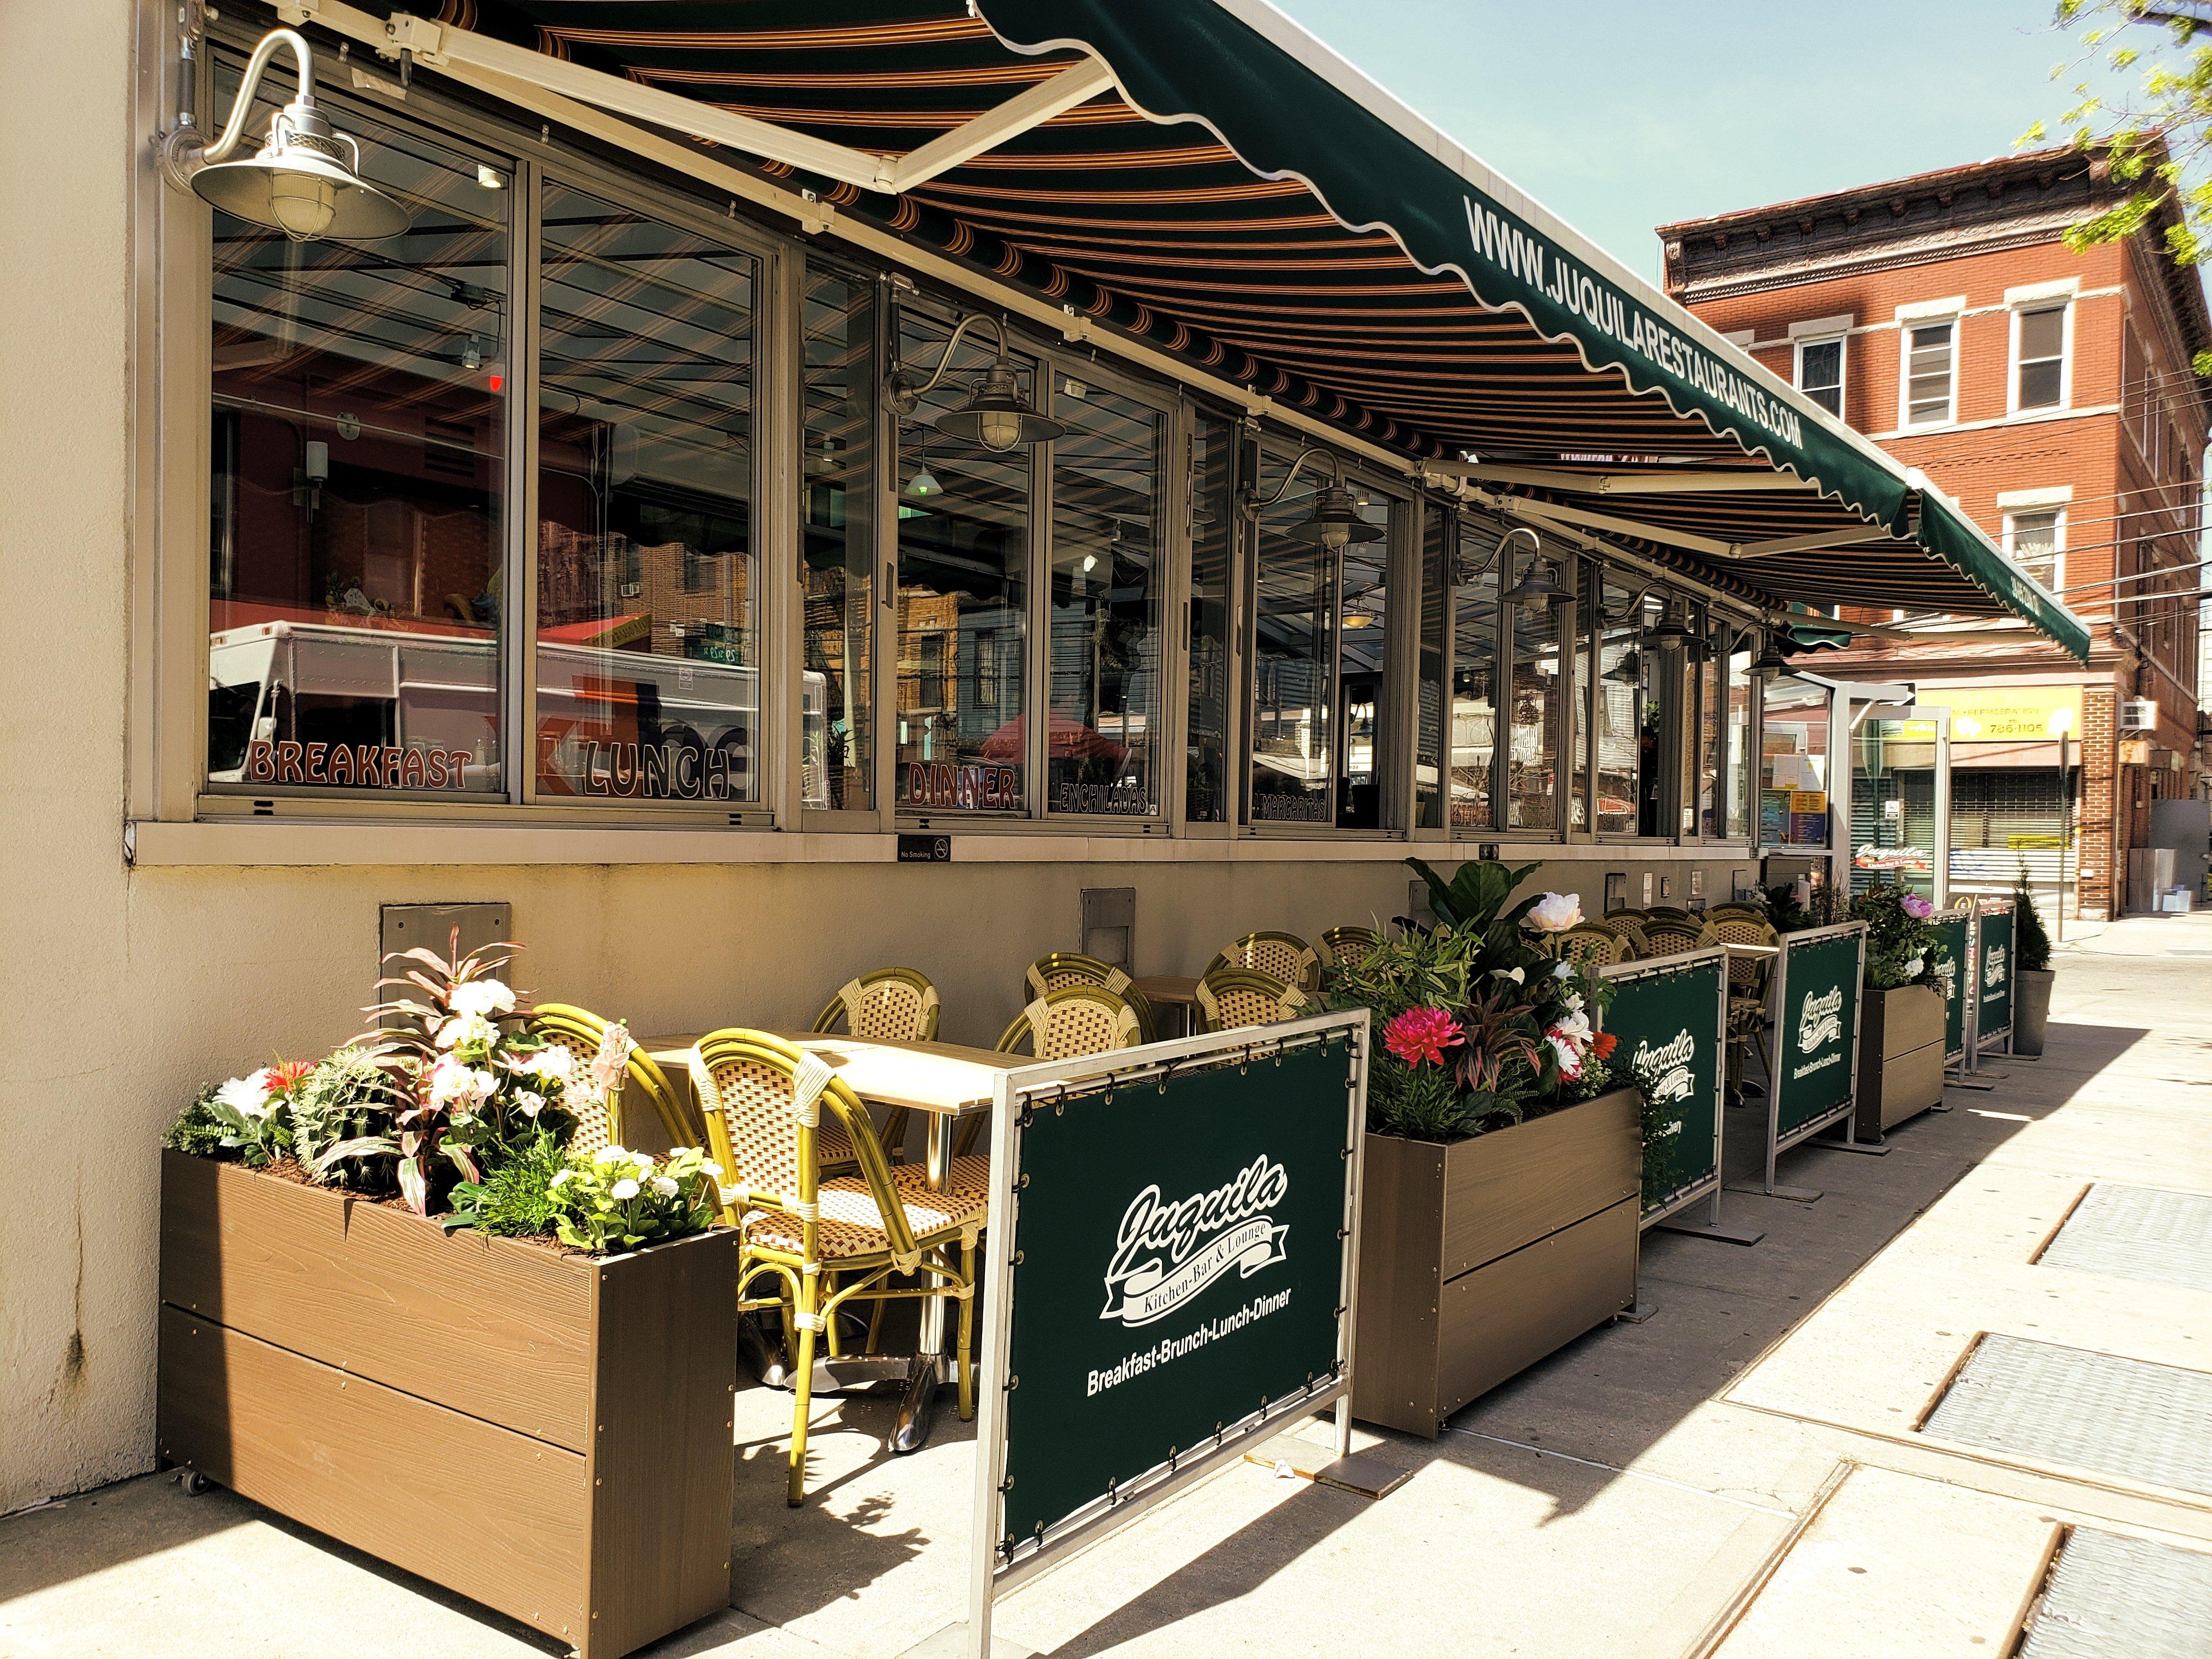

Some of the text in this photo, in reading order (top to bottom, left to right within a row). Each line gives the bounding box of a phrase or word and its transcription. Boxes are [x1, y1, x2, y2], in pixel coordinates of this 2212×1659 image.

[1463, 194, 1803, 450] WWW.JUQUILARESTAURANTS.COM
[250, 740, 473, 789] BREAKFAST
[585, 741, 730, 800] LUNCH
[909, 762, 1016, 809] DINNER
[1060, 783, 1147, 815] ENCHILADAS
[1262, 795, 1325, 821] MARGARITAS
[909, 850, 931, 859] Smoking
[1107, 1154, 1288, 1283] Juquila
[1143, 1222, 1267, 1314] Kitchen-Bar & Lounge
[1087, 1288, 1292, 1397] Breakfast-Brunch-Lunch-Dinner
